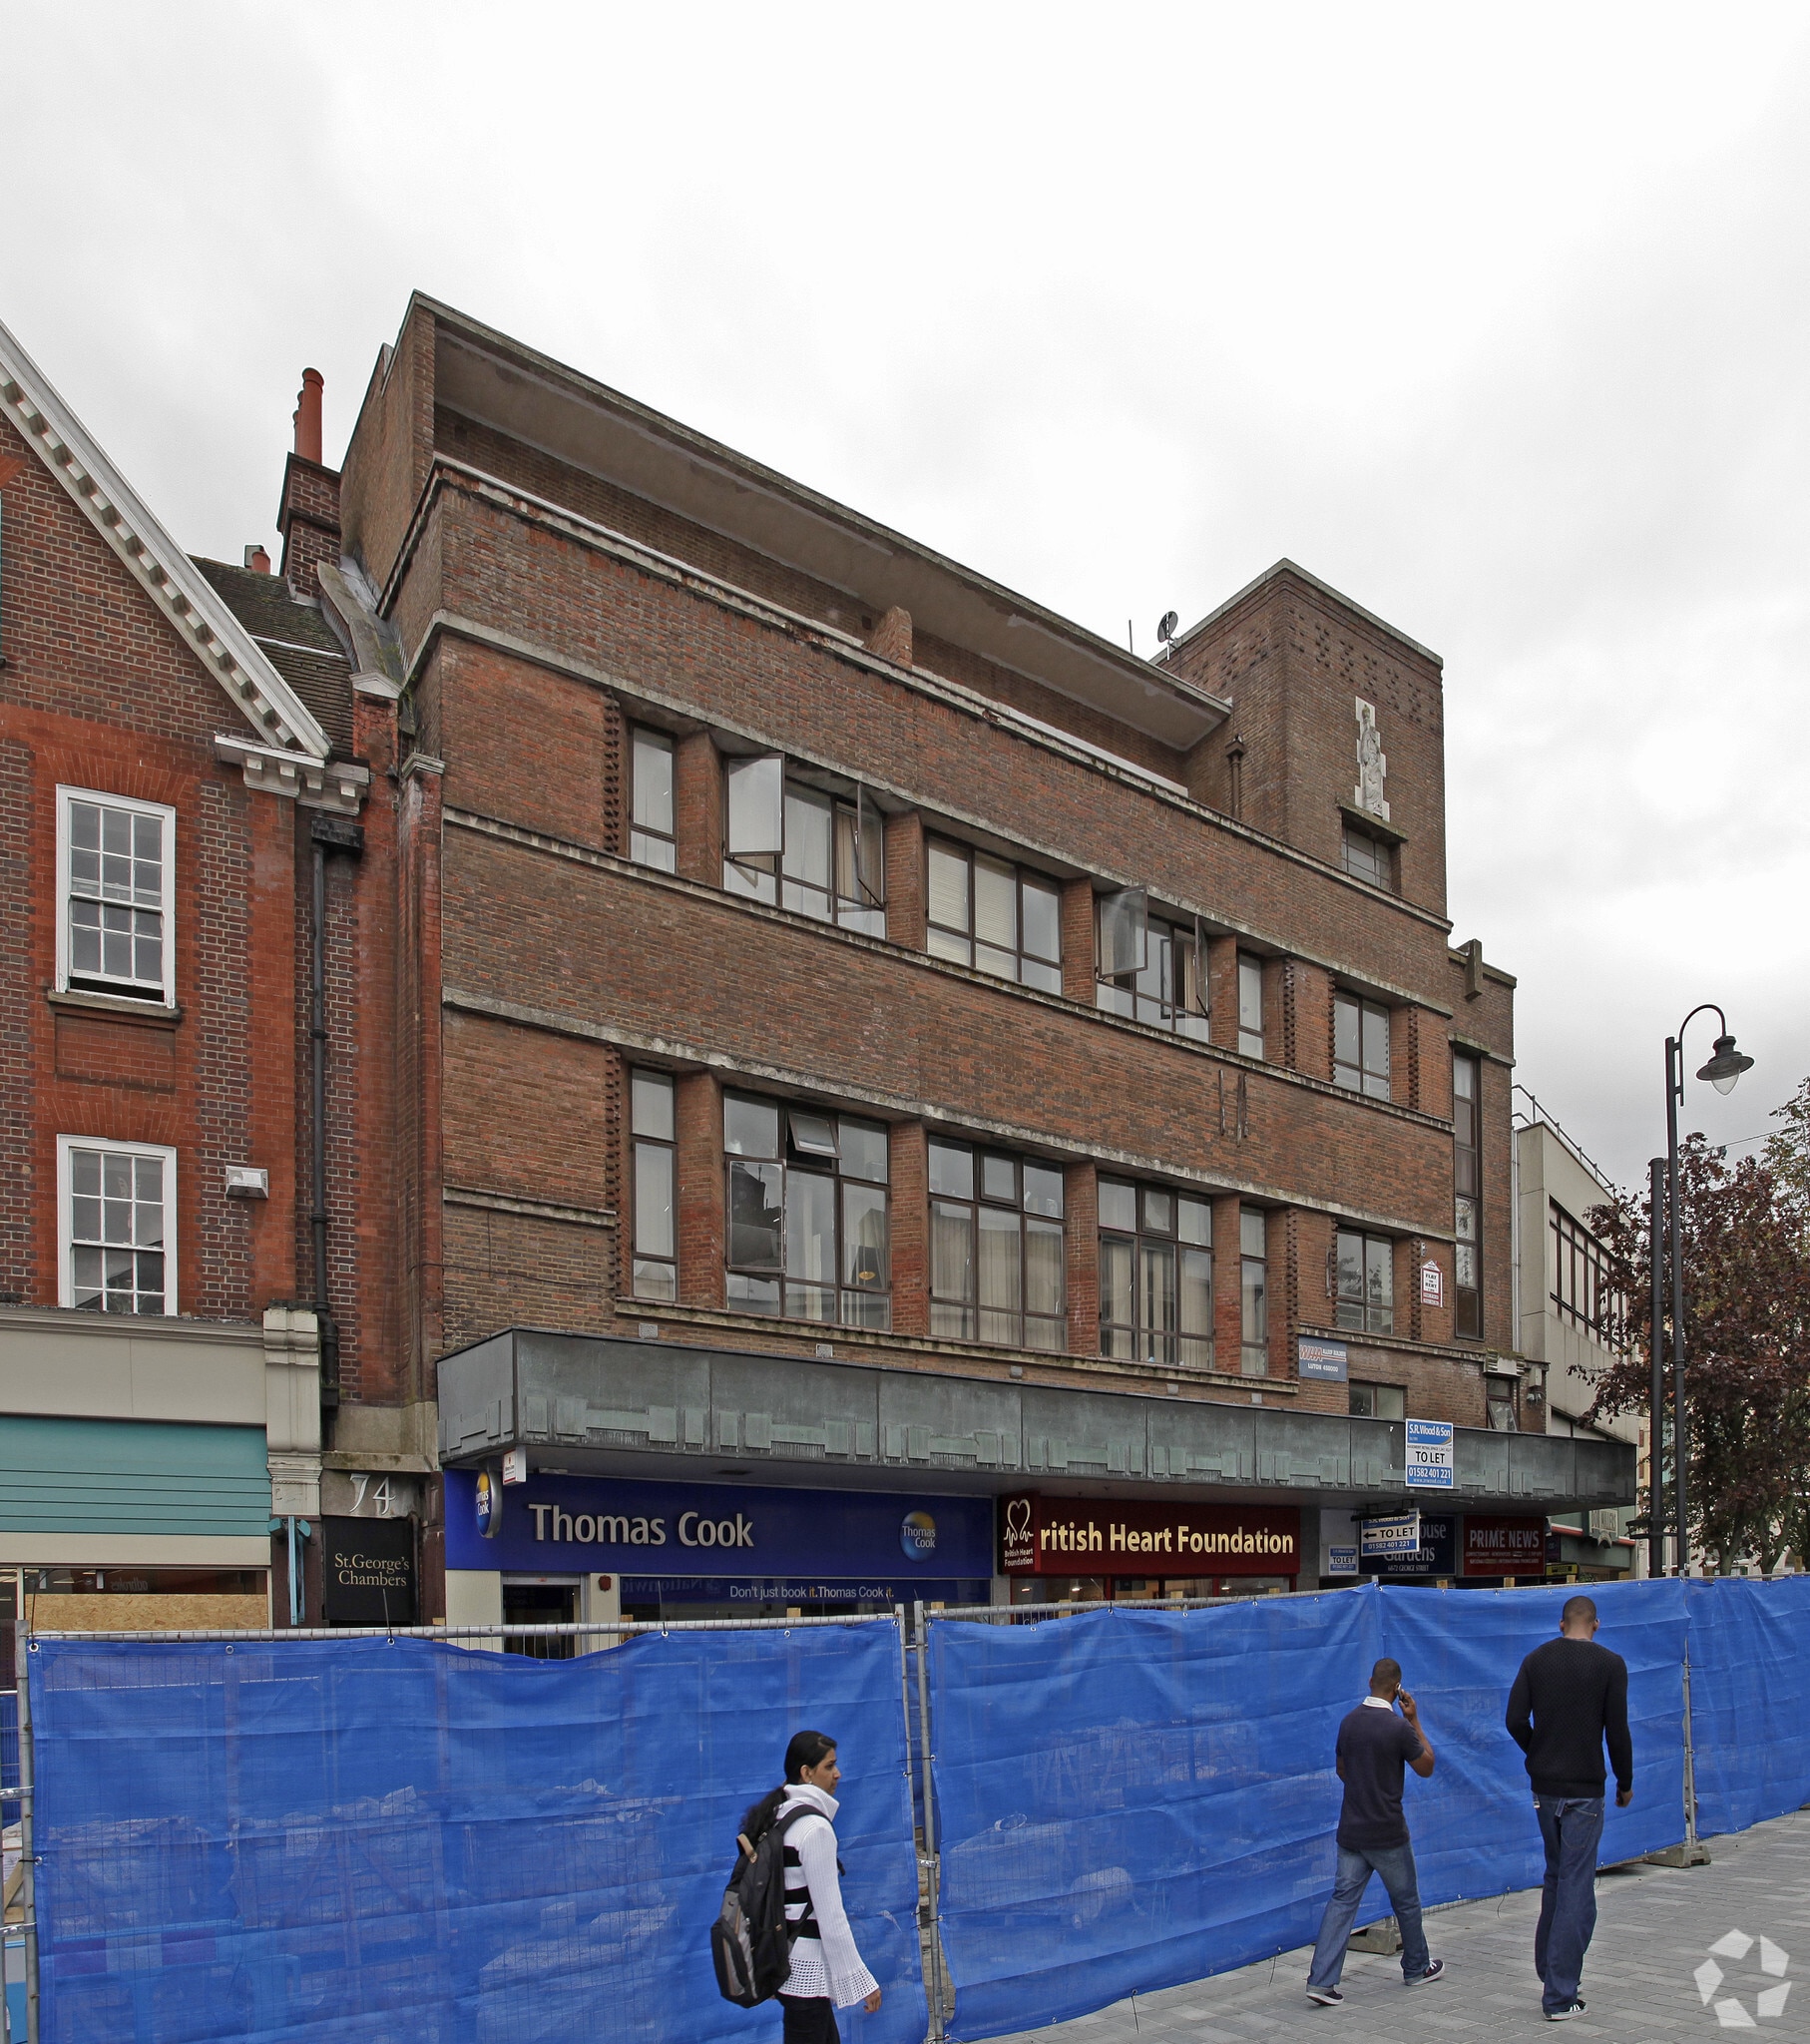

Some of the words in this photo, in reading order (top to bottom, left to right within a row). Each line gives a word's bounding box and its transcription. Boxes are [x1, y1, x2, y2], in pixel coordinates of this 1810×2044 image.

[1436, 1427, 1440, 1436] &
[1441, 1427, 1451, 1437] Son
[1415, 1450, 1428, 1463] TO
[1430, 1452, 1445, 1464] LET
[1408, 1467, 1428, 1477] 01582
[1428, 1467, 1439, 1478] 401
[1440, 1468, 1451, 1478] 221
[349, 1473, 395, 1515] 74
[477, 1501, 490, 1516] Cook
[528, 1503, 666, 1545] Thomas
[679, 1511, 754, 1547] Cook
[902, 1526, 936, 1537] Thomas
[1380, 1529, 1394, 1538] TO
[1397, 1526, 1415, 1537] LET
[1419, 1523, 1447, 1539] ouse
[915, 1537, 936, 1548] Cook
[1041, 1521, 1103, 1552] ritish
[1110, 1523, 1172, 1553] Heart
[1177, 1526, 1294, 1554] Foundation
[1470, 1529, 1506, 1548] PRIME
[1509, 1530, 1540, 1548] NEWS
[1004, 1549, 1019, 1558] British
[1004, 1557, 1034, 1567] Foundation
[338, 1570, 407, 1587] Chambers
[729, 1585, 757, 1598] Don't
[759, 1586, 778, 1600] just
[781, 1586, 806, 1597] book
[808, 1585, 817, 1597] it.
[817, 1586, 856, 1597] Thomas
[858, 1586, 883, 1597] Cook
